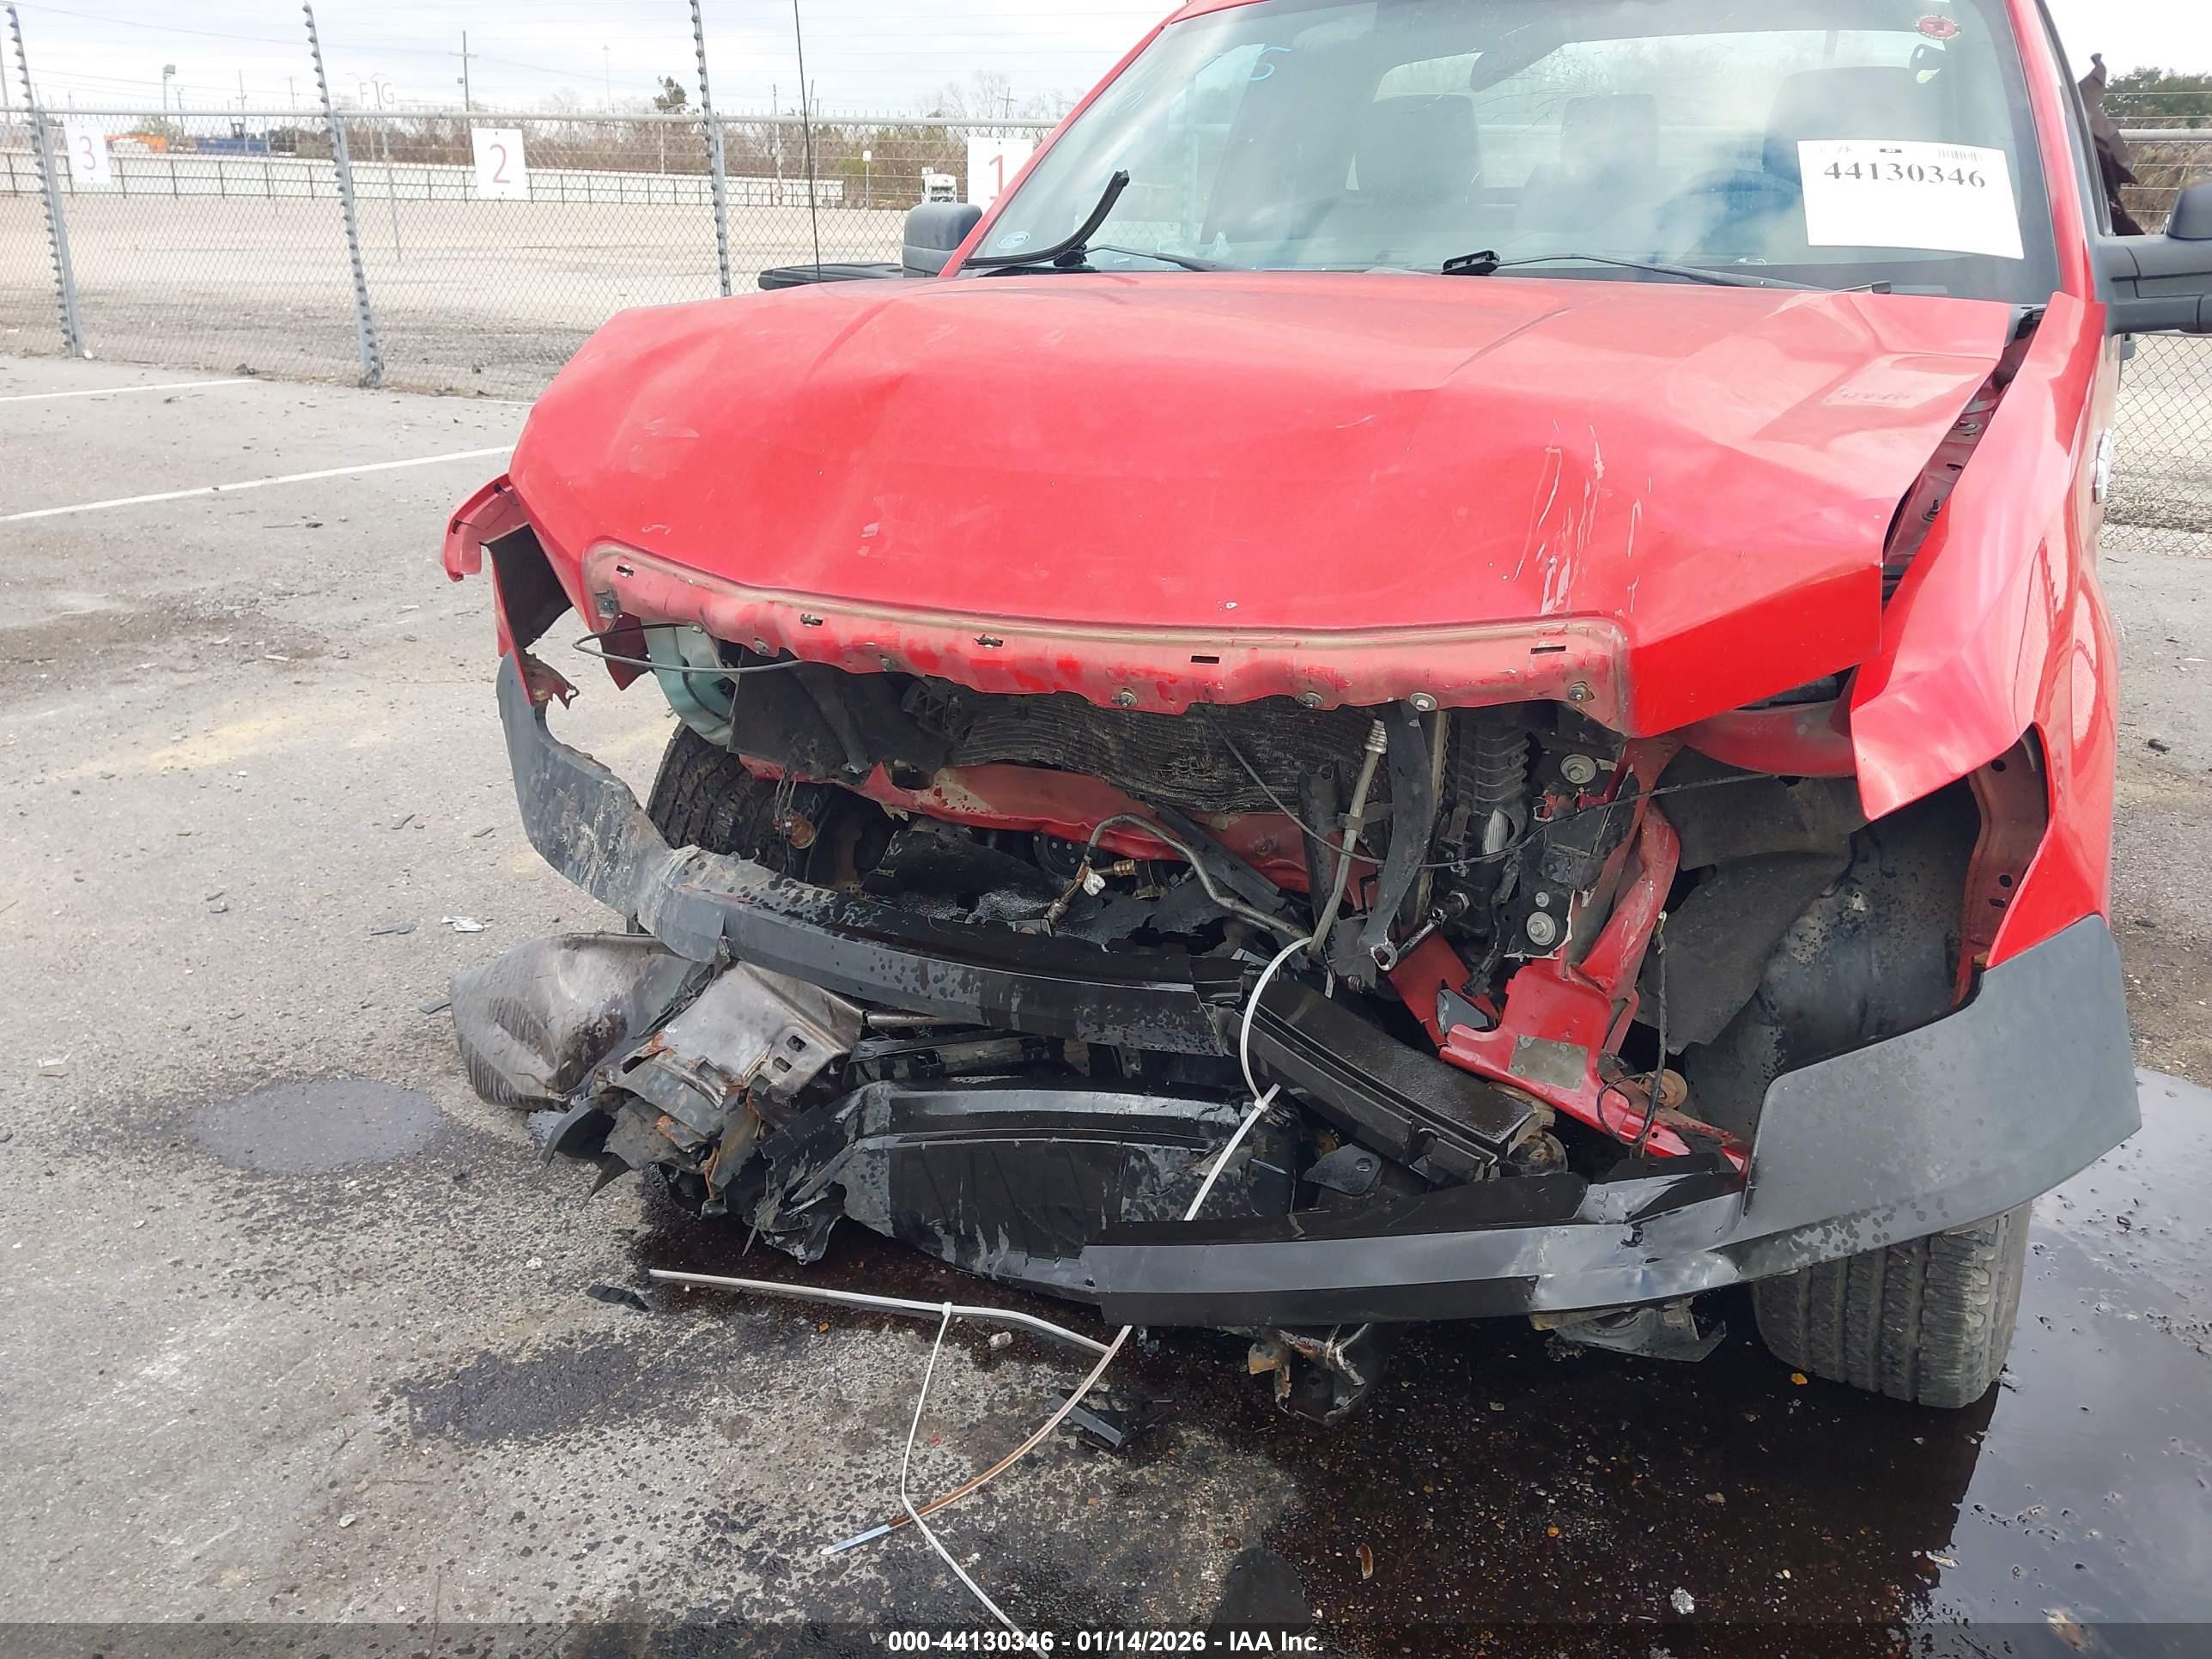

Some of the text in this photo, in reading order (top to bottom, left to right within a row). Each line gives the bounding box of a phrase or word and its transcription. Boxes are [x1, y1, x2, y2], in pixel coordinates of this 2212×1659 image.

[79, 135, 96, 170] 3
[489, 143, 511, 183] 2
[988, 155, 1004, 200] 1
[1824, 161, 1985, 188] 44130346
